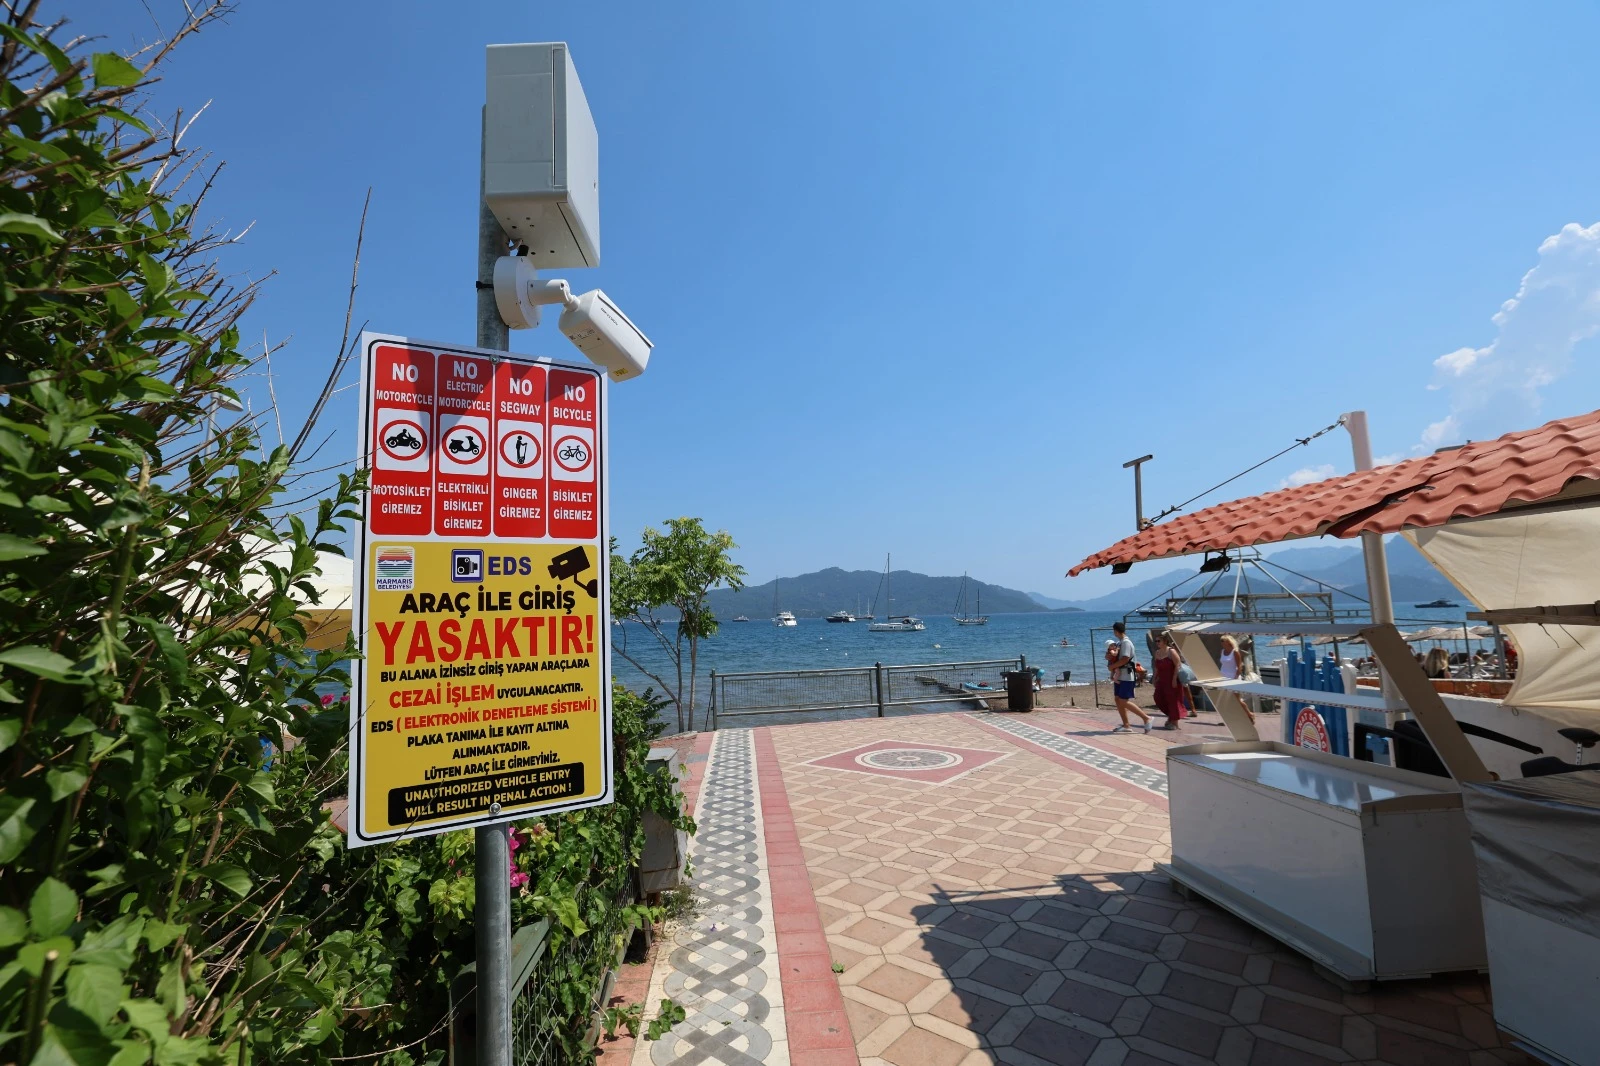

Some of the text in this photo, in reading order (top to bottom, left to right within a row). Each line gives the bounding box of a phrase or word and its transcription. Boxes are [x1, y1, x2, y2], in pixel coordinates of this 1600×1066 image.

[392, 363, 418, 382] NO
[454, 361, 477, 378] NO
[447, 381, 483, 394] ELECTRIC
[510, 378, 532, 395] NO
[564, 385, 585, 402] NO
[377, 390, 432, 405] MOTORCYCLE
[439, 397, 490, 411] MOTORCYCLE
[501, 401, 540, 416] SEGWAY
[554, 407, 591, 421] BICYCLE
[374, 484, 431, 497] MOTOSİKLET
[438, 482, 488, 495] ELEKTRİKLİ
[503, 488, 537, 500] GINGER
[553, 491, 592, 503] BİSİKLET
[382, 502, 421, 515] GİREMEZ
[444, 500, 483, 512] BİSİKLET
[500, 505, 540, 519] GİREMEZ
[444, 517, 482, 529] GİREMEZ
[554, 509, 592, 521] GİREMEZ
[488, 556, 531, 575] EDS
[399, 584, 575, 618] ARAÇ İLE GİRİŞ
[375, 615, 594, 665] YASAKTIR!
[381, 659, 589, 682] BU ALANA İZİNSİZ GİRİŞ YAPAN ARAÇLARA
[389, 682, 583, 708] CEZAİ İŞLEM UYGULANACAKTIR.
[371, 720, 393, 733] EDS
[405, 708, 479, 729] ELEKTRONİK
[482, 704, 548, 721] DENETLEME
[551, 697, 591, 715] SİSTEMİ
[408, 719, 569, 747] PLAKA TANIMA İLE KAYIT ALTINA
[453, 741, 530, 759] ALINMAKTADIR.
[425, 753, 560, 781] LÜTFEN ARAÇ İLE GİRMEYİNİZ.
[405, 769, 570, 803] UNAUTHORIZED VEHICLE ENTRY
[405, 805, 434, 818] WILL
[437, 798, 476, 813] RESULT
[480, 795, 491, 806] IN
[494, 790, 527, 804] PENAL
[530, 785, 566, 798] ACTION
